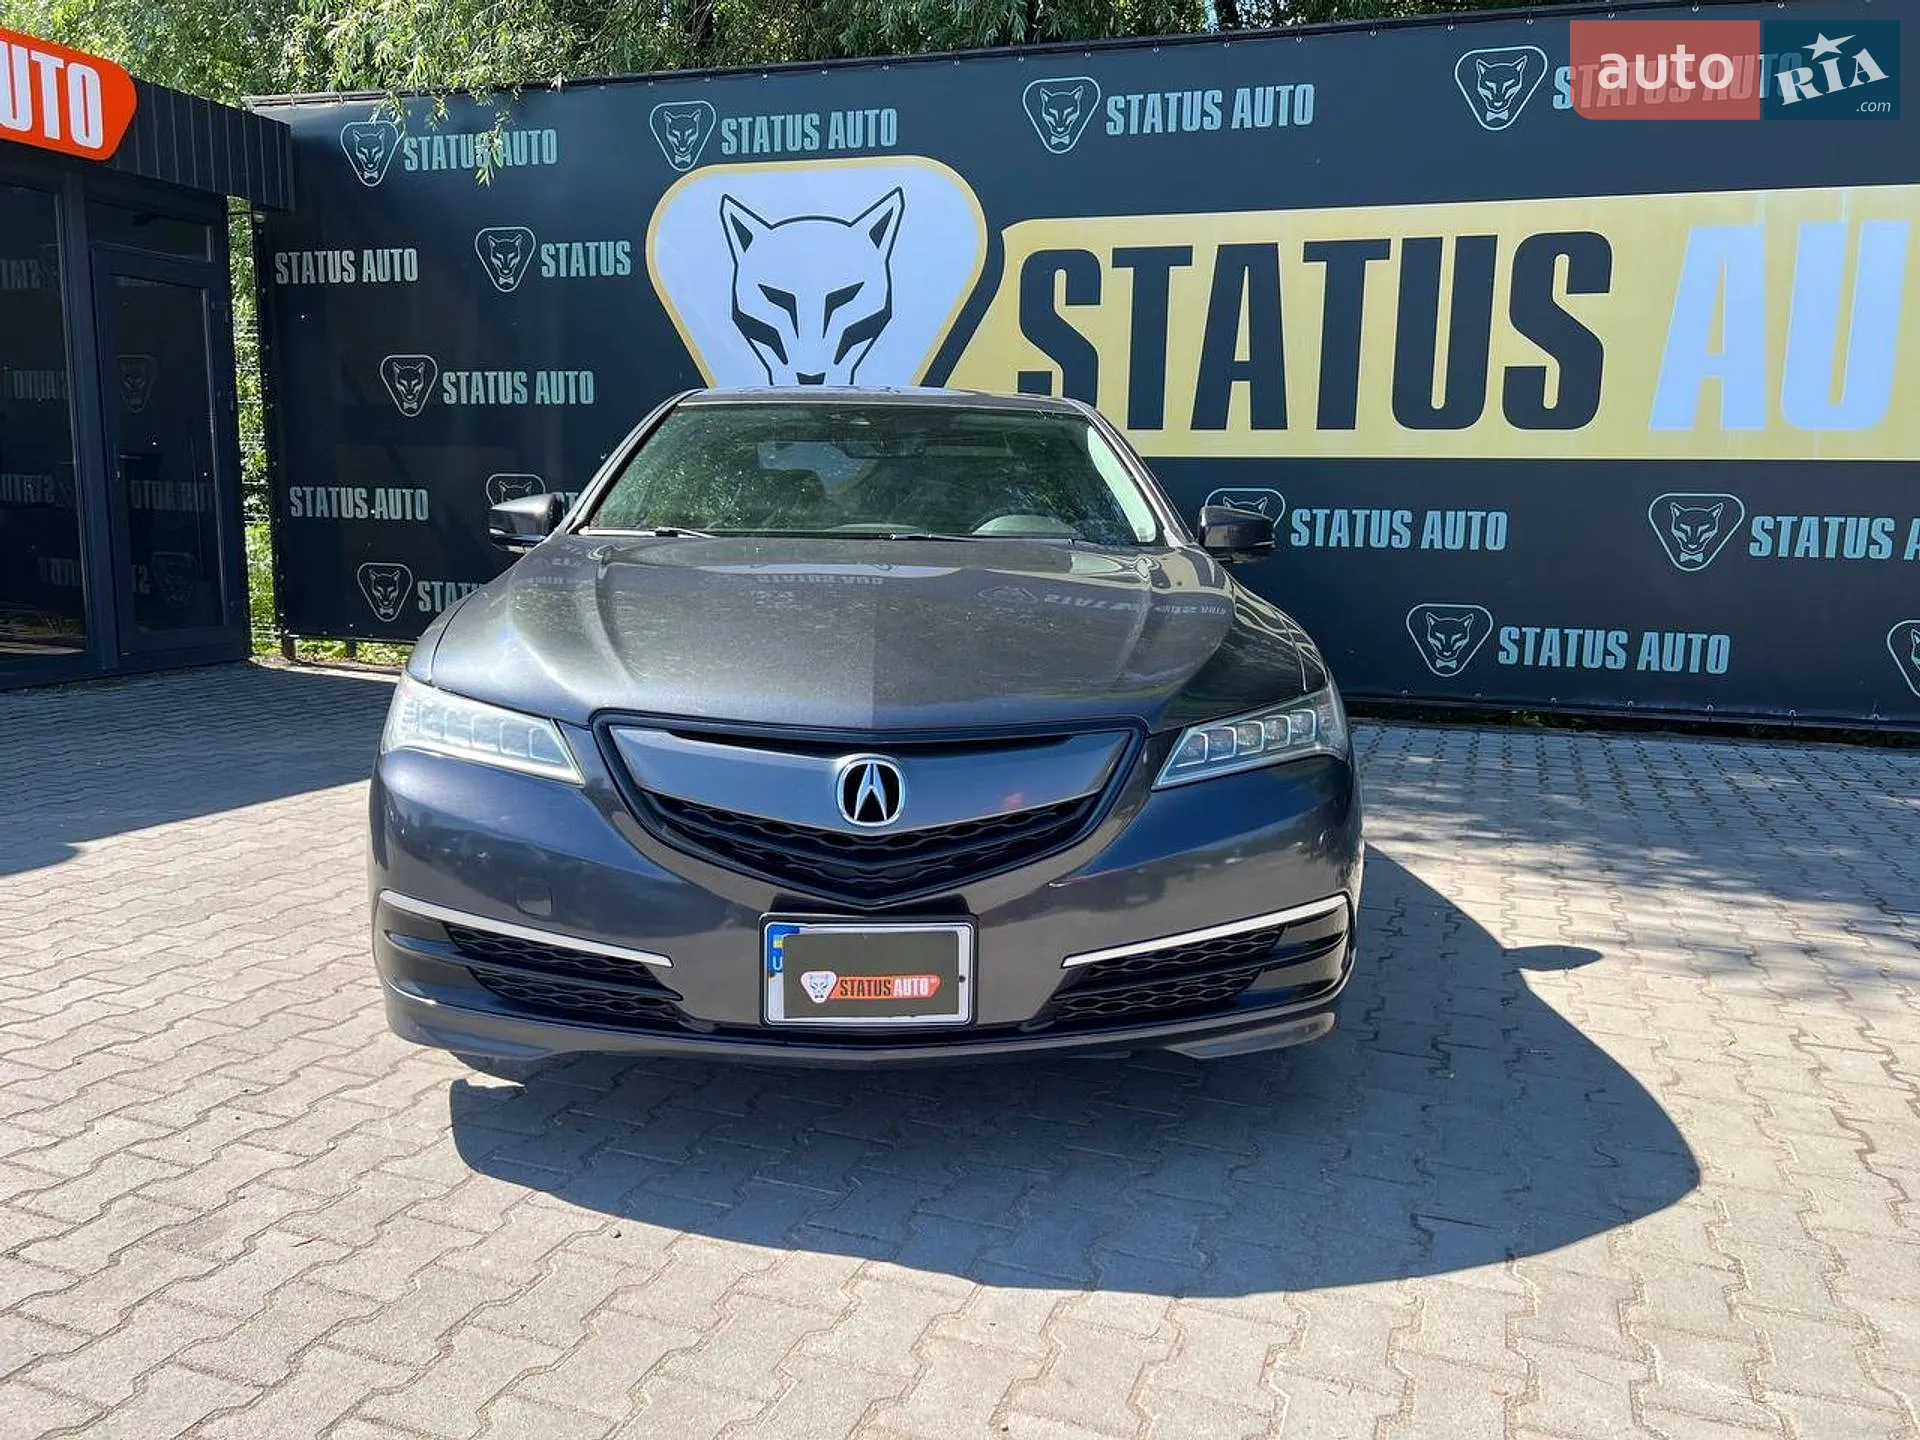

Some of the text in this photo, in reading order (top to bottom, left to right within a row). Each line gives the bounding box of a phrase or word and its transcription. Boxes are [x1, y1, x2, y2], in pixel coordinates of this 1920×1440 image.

[1105, 83, 1315, 136] STATUS AUTO
[721, 108, 897, 155] STATUS AUTO
[275, 248, 418, 284] STATUS AUTO
[541, 240, 632, 277] STATUS
[1016, 231, 1613, 430] STATUS
[442, 370, 594, 405] STATUS AUTO
[289, 486, 429, 521] STATUS AUTO
[1290, 508, 1508, 551] STATUS AUTO
[1749, 515, 1896, 560] STATUS
[1498, 626, 1731, 675] STATUS AUTO
[840, 977, 928, 996] STATUS AUTO
